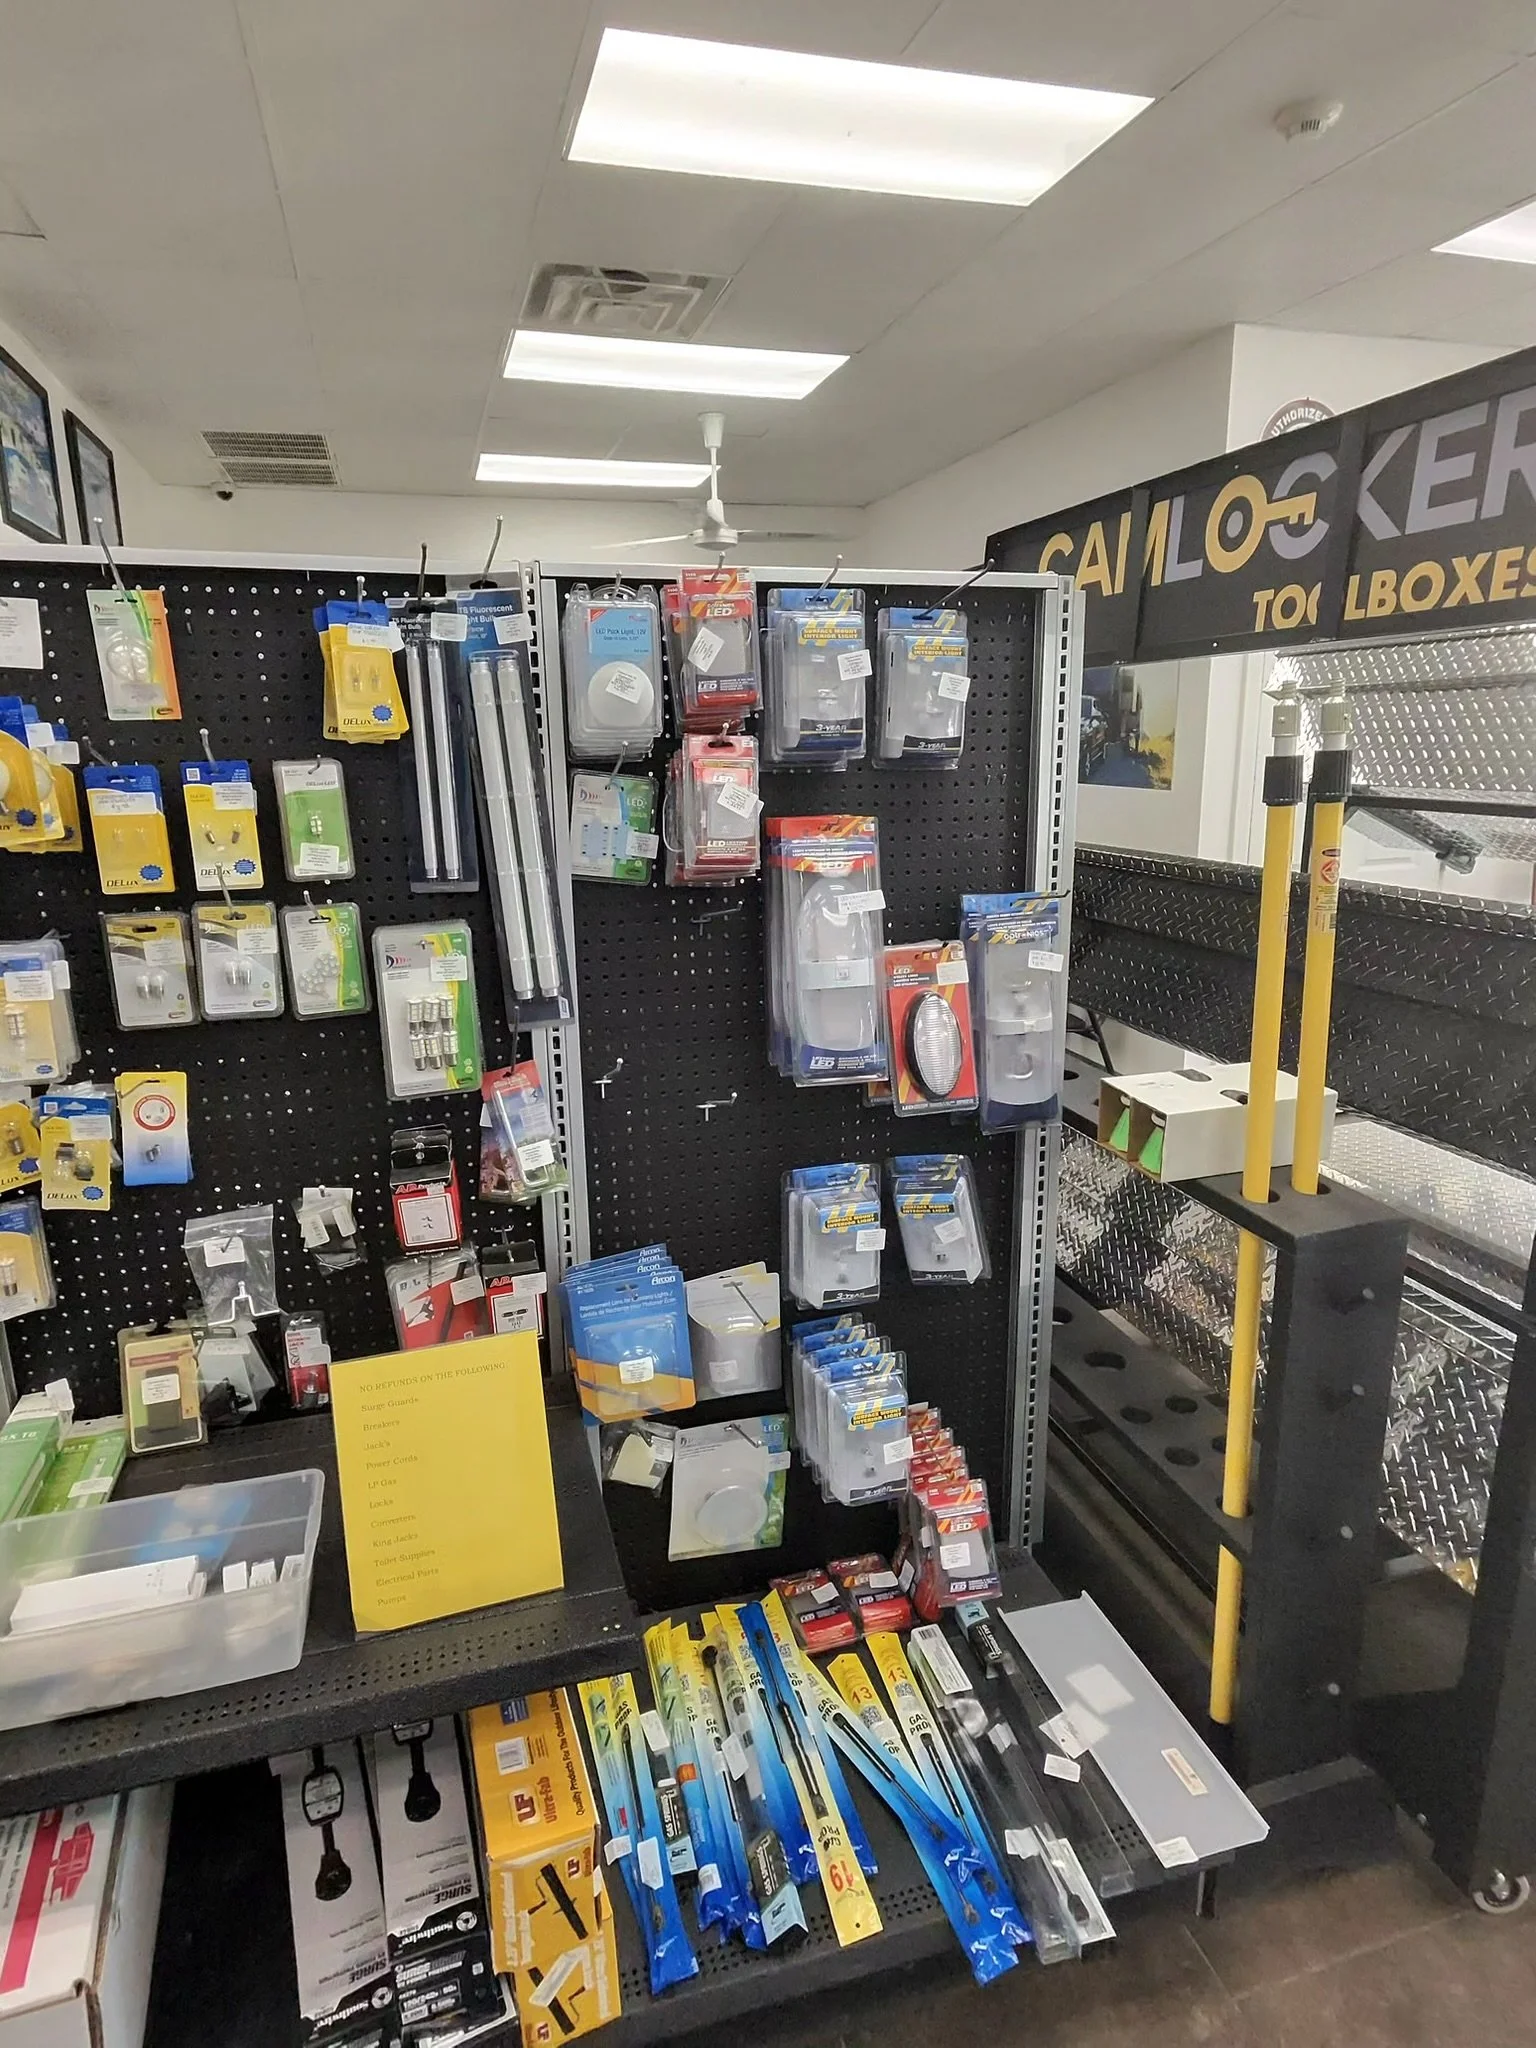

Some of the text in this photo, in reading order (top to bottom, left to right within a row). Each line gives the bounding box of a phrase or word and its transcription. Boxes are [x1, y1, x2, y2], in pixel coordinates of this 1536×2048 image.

[470, 604, 513, 613] Fluorescent
[706, 608, 733, 616] LED
[627, 797, 644, 807] LED
[810, 1059, 835, 1067] LED
[637, 1263, 660, 1273] Arcon
[651, 1275, 676, 1286] Arcon
[360, 1361, 506, 1393] NO REFUNDS ON THE FOLLOWING
[361, 1397, 419, 1413] Surge Guards
[363, 1419, 401, 1432] Breakers
[364, 1440, 391, 1451] Jack's
[365, 1454, 419, 1471] Power Cords
[368, 1479, 397, 1490] LP Gas
[369, 1498, 394, 1509] Locks
[370, 1514, 417, 1529] Converters
[950, 1523, 972, 1532] LED
[372, 1532, 419, 1548] King Jacks
[373, 1549, 436, 1568] Toilet Supplies
[376, 1567, 439, 1588] Electrical Parts
[950, 1581, 967, 1591] LED
[377, 1595, 407, 1607] Pumps
[858, 1595, 875, 1604] LED
[851, 1686, 873, 1704] 13
[554, 1712, 585, 1816] Quality Products For The Outdoor
[536, 1776, 558, 1824] Ultra-Fab
[514, 1793, 536, 1823] UF
[829, 1860, 854, 1893] 19
[434, 1884, 472, 1905] SURGE
[398, 1921, 453, 1948] Southwire
[347, 1958, 387, 1985] SURGE
[313, 1999, 369, 2031] Southwire
